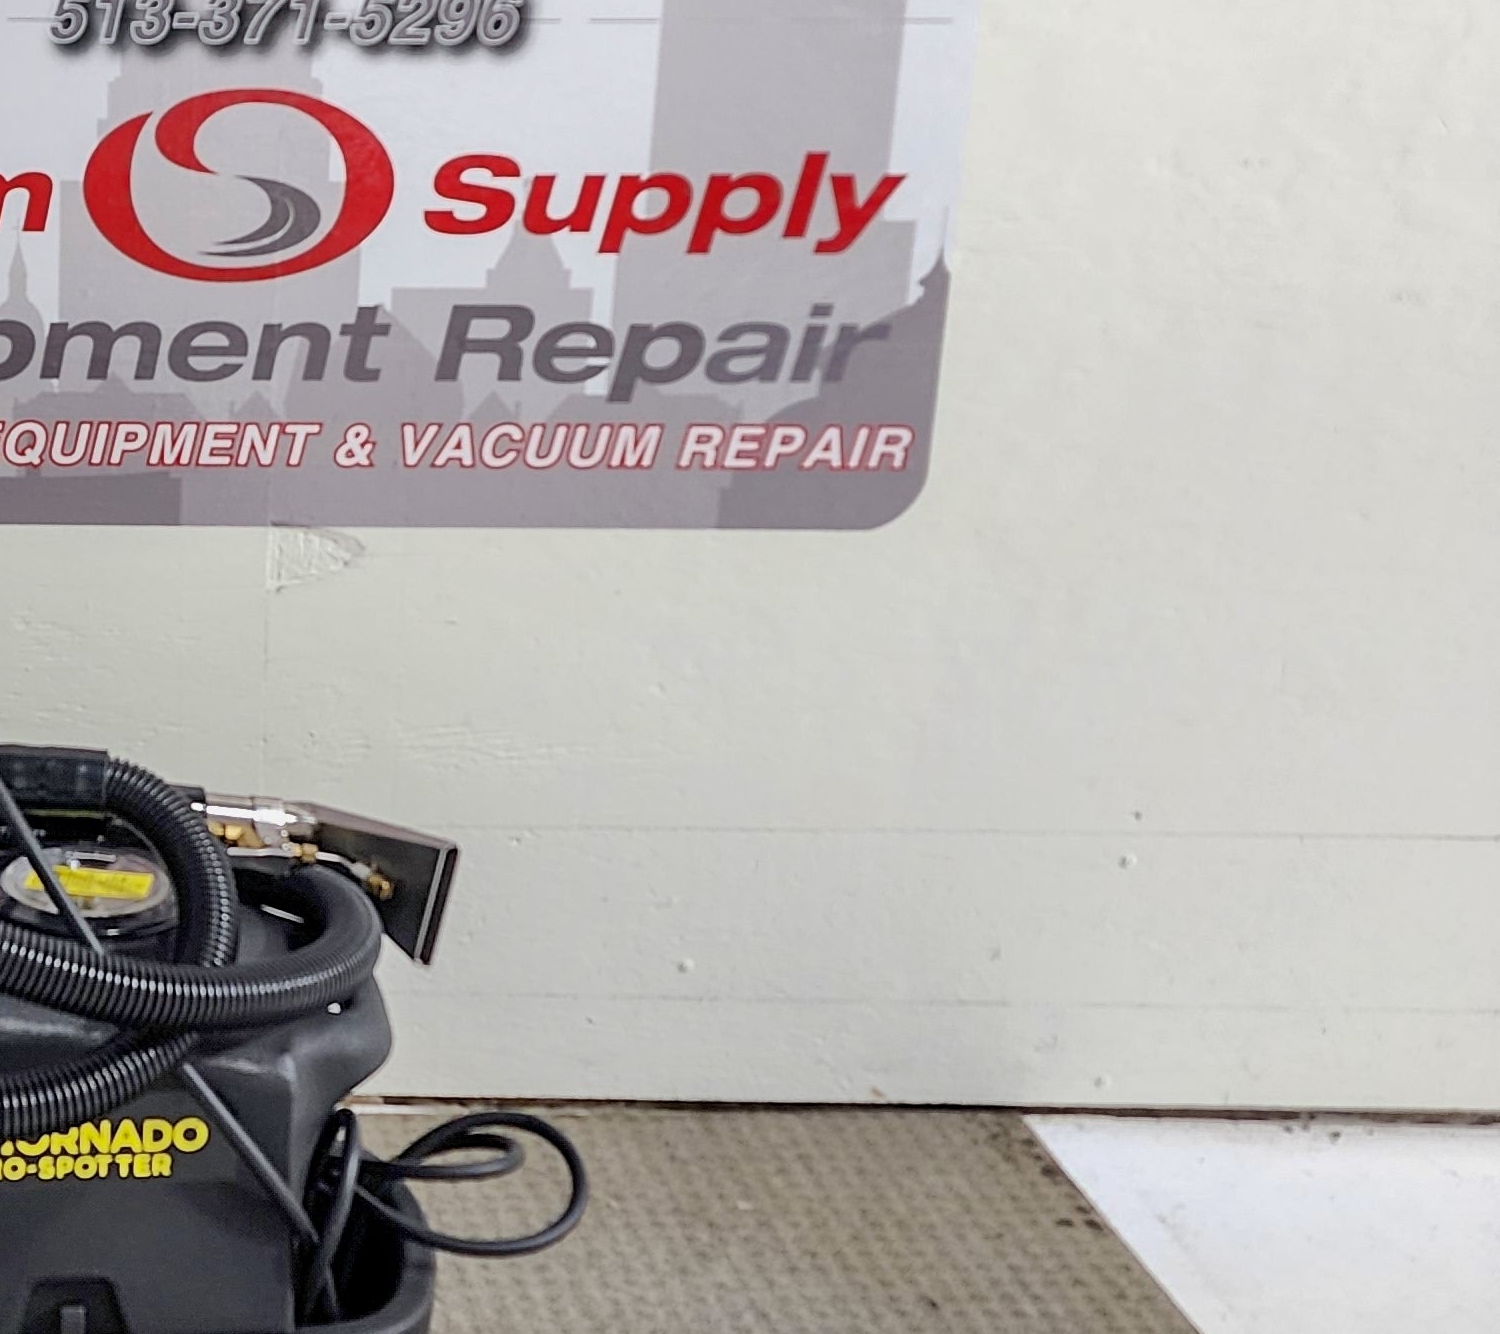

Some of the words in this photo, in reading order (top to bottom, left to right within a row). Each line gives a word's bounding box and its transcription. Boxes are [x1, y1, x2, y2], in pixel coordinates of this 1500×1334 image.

[423, 151, 907, 255] Supply
[434, 304, 892, 403] Repair
[333, 423, 376, 468] &
[399, 423, 666, 469] VACUUM
[678, 424, 913, 471] REPAIR
[0, 1116, 210, 1157] RNADO
